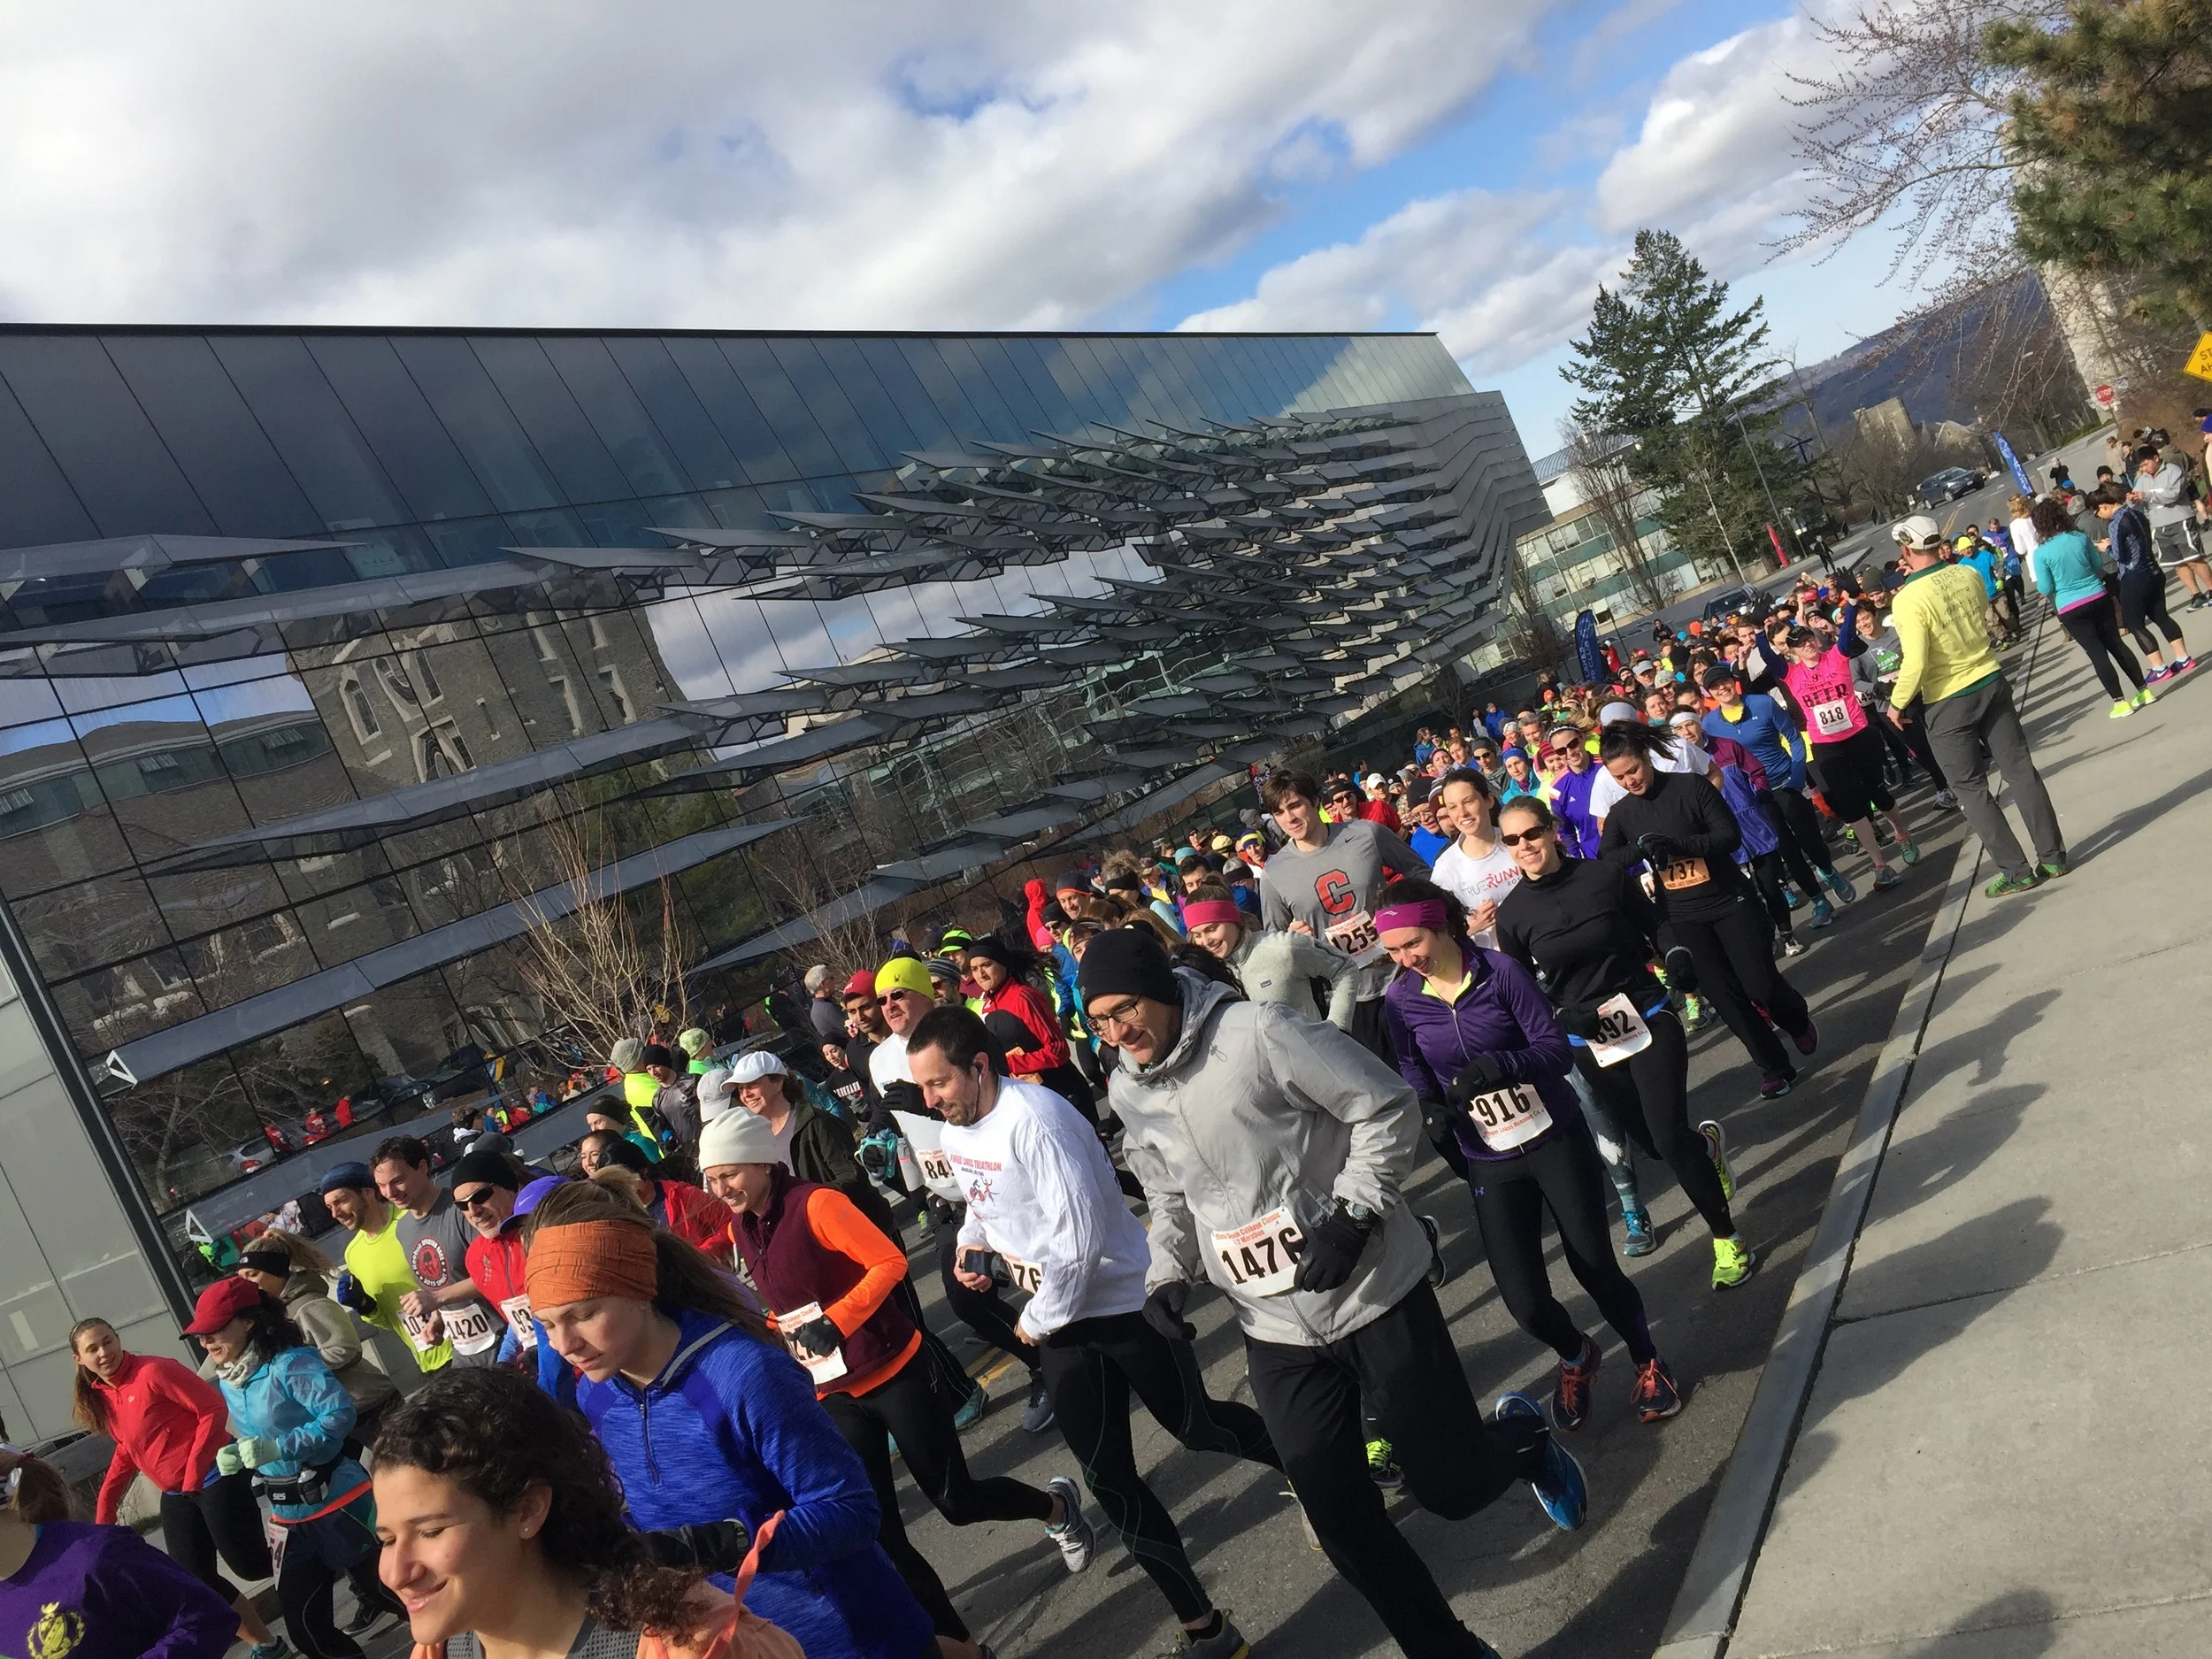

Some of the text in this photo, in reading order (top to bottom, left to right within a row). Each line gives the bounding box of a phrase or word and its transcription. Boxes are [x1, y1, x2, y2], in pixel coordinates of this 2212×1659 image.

[2096, 388, 2113, 400] STOP
[1931, 566, 1962, 586] STAFF
[1801, 683, 1848, 708] BEER
[1819, 706, 1844, 726] 818
[1668, 859, 1695, 882] 737
[1314, 868, 1356, 916] C
[1475, 1085, 1531, 1127] 916
[973, 1159, 1002, 1171] TRIATHLON
[1221, 1226, 1302, 1285] 1476
[446, 1313, 489, 1340] 1420
[511, 1305, 534, 1334] 93
